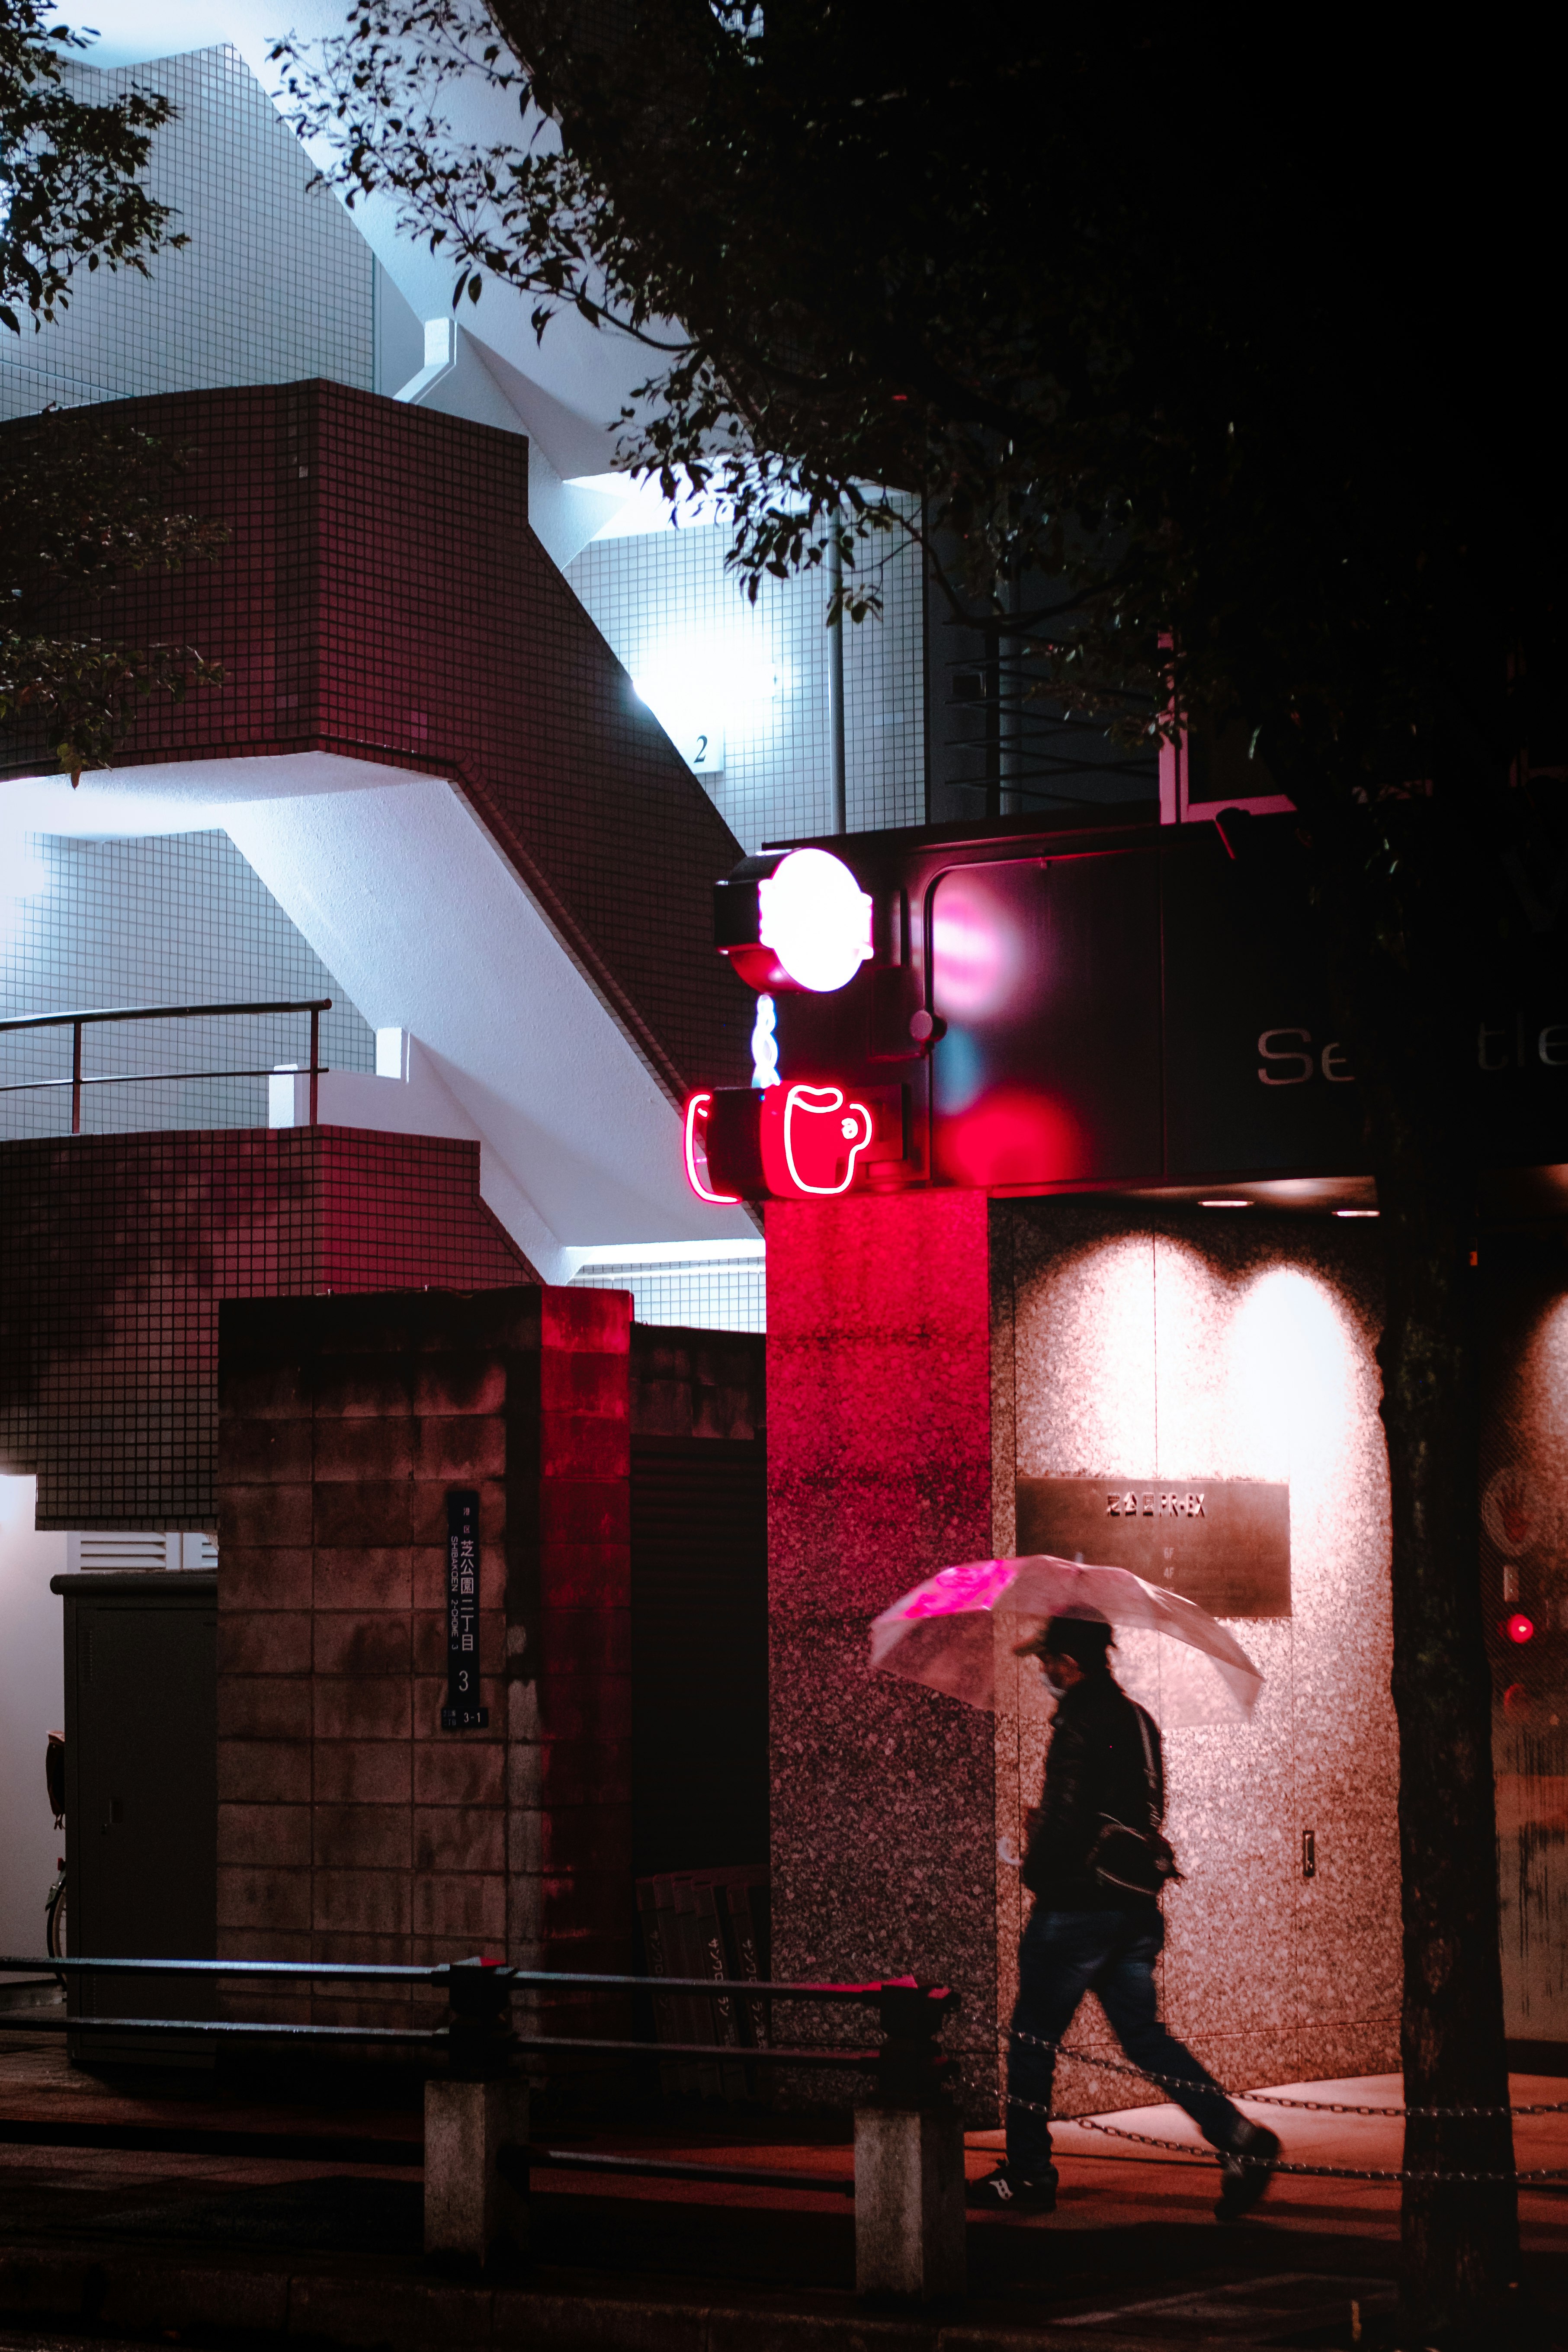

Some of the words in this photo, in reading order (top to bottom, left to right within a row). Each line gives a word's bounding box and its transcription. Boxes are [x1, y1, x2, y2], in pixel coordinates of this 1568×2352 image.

[693, 735, 708, 764] 2
[463, 1507, 470, 1534] 港区
[460, 1540, 474, 1651] 芝公園二丁目
[459, 1670, 468, 1692] 3
[464, 1712, 481, 1723] 3-1
